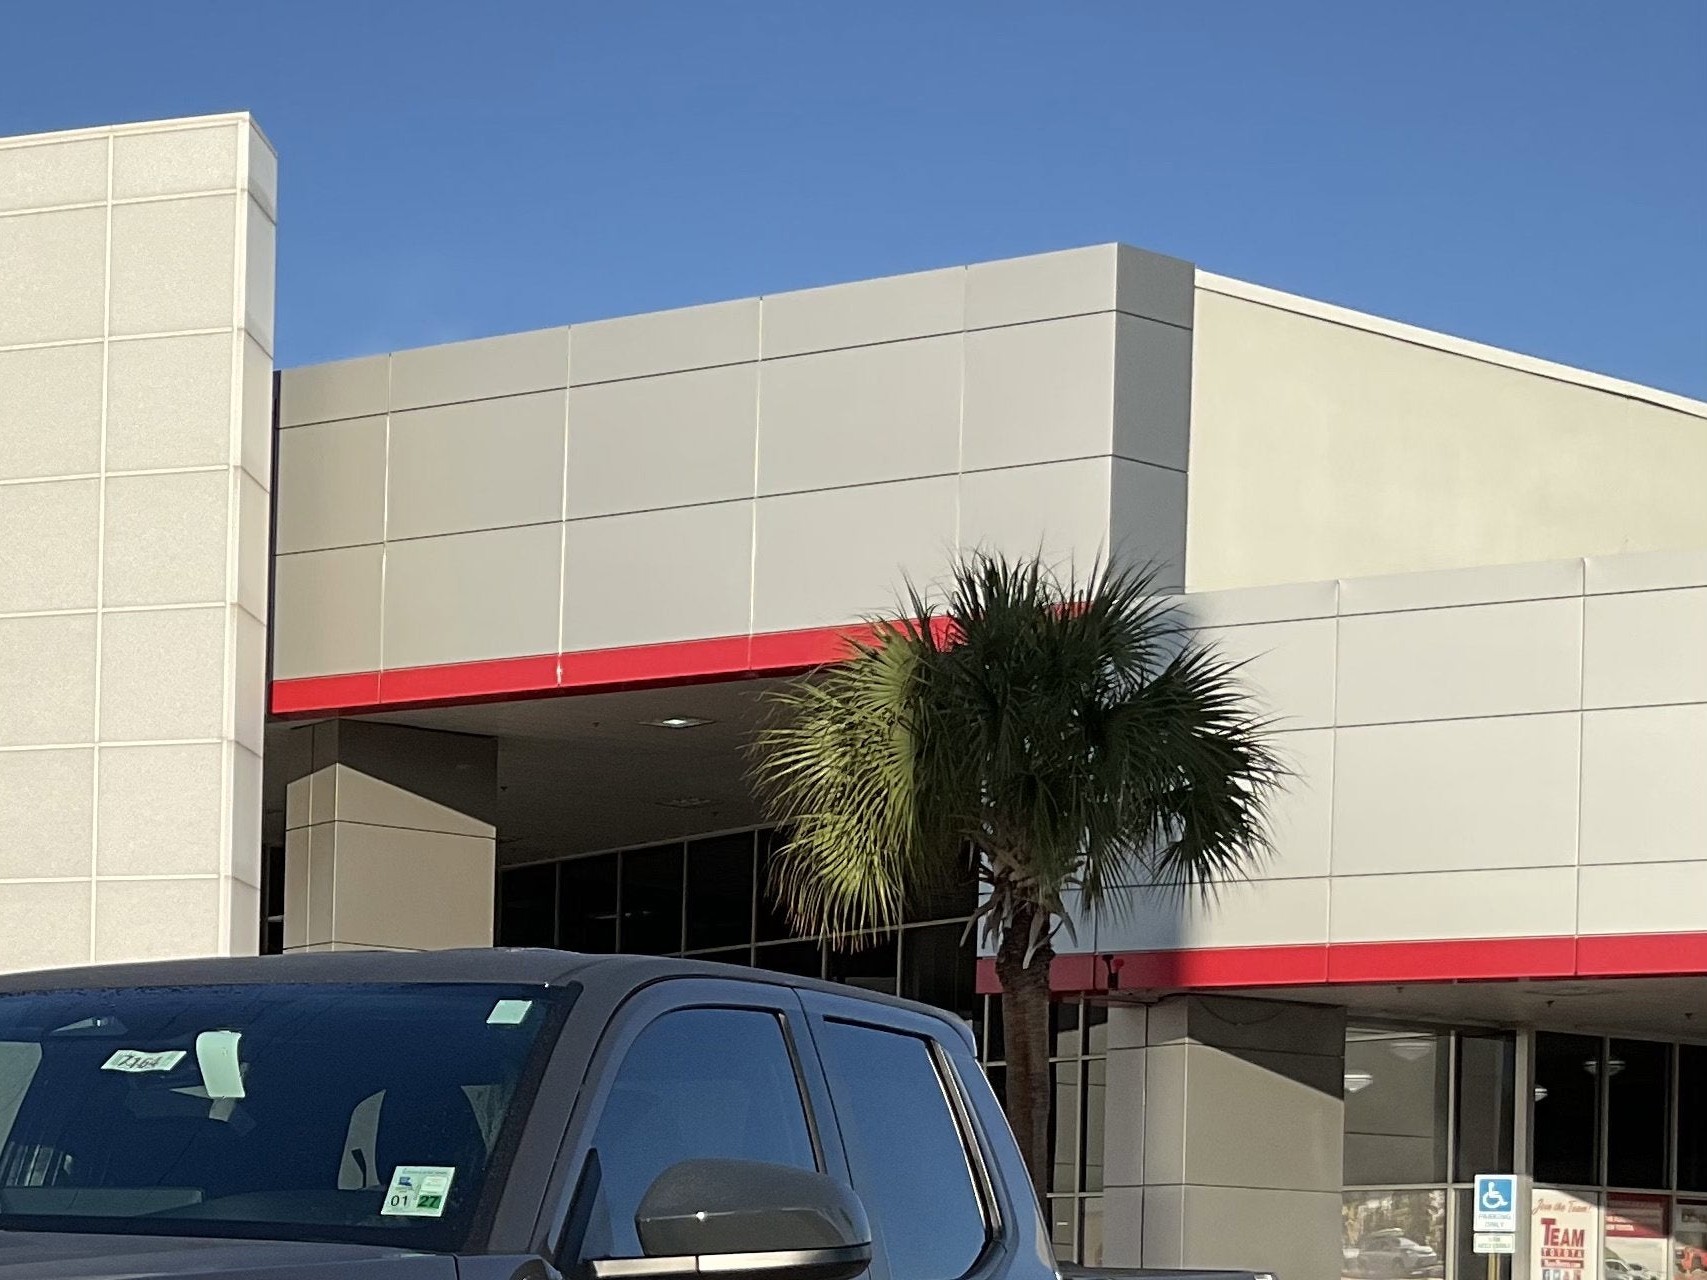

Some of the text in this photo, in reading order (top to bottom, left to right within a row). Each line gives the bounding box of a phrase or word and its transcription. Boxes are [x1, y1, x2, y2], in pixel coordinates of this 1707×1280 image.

[390, 1195, 441, 1208] 01 27
[1540, 1217, 1585, 1247] TEAM
[1542, 1248, 1584, 1258] TOYOTA
